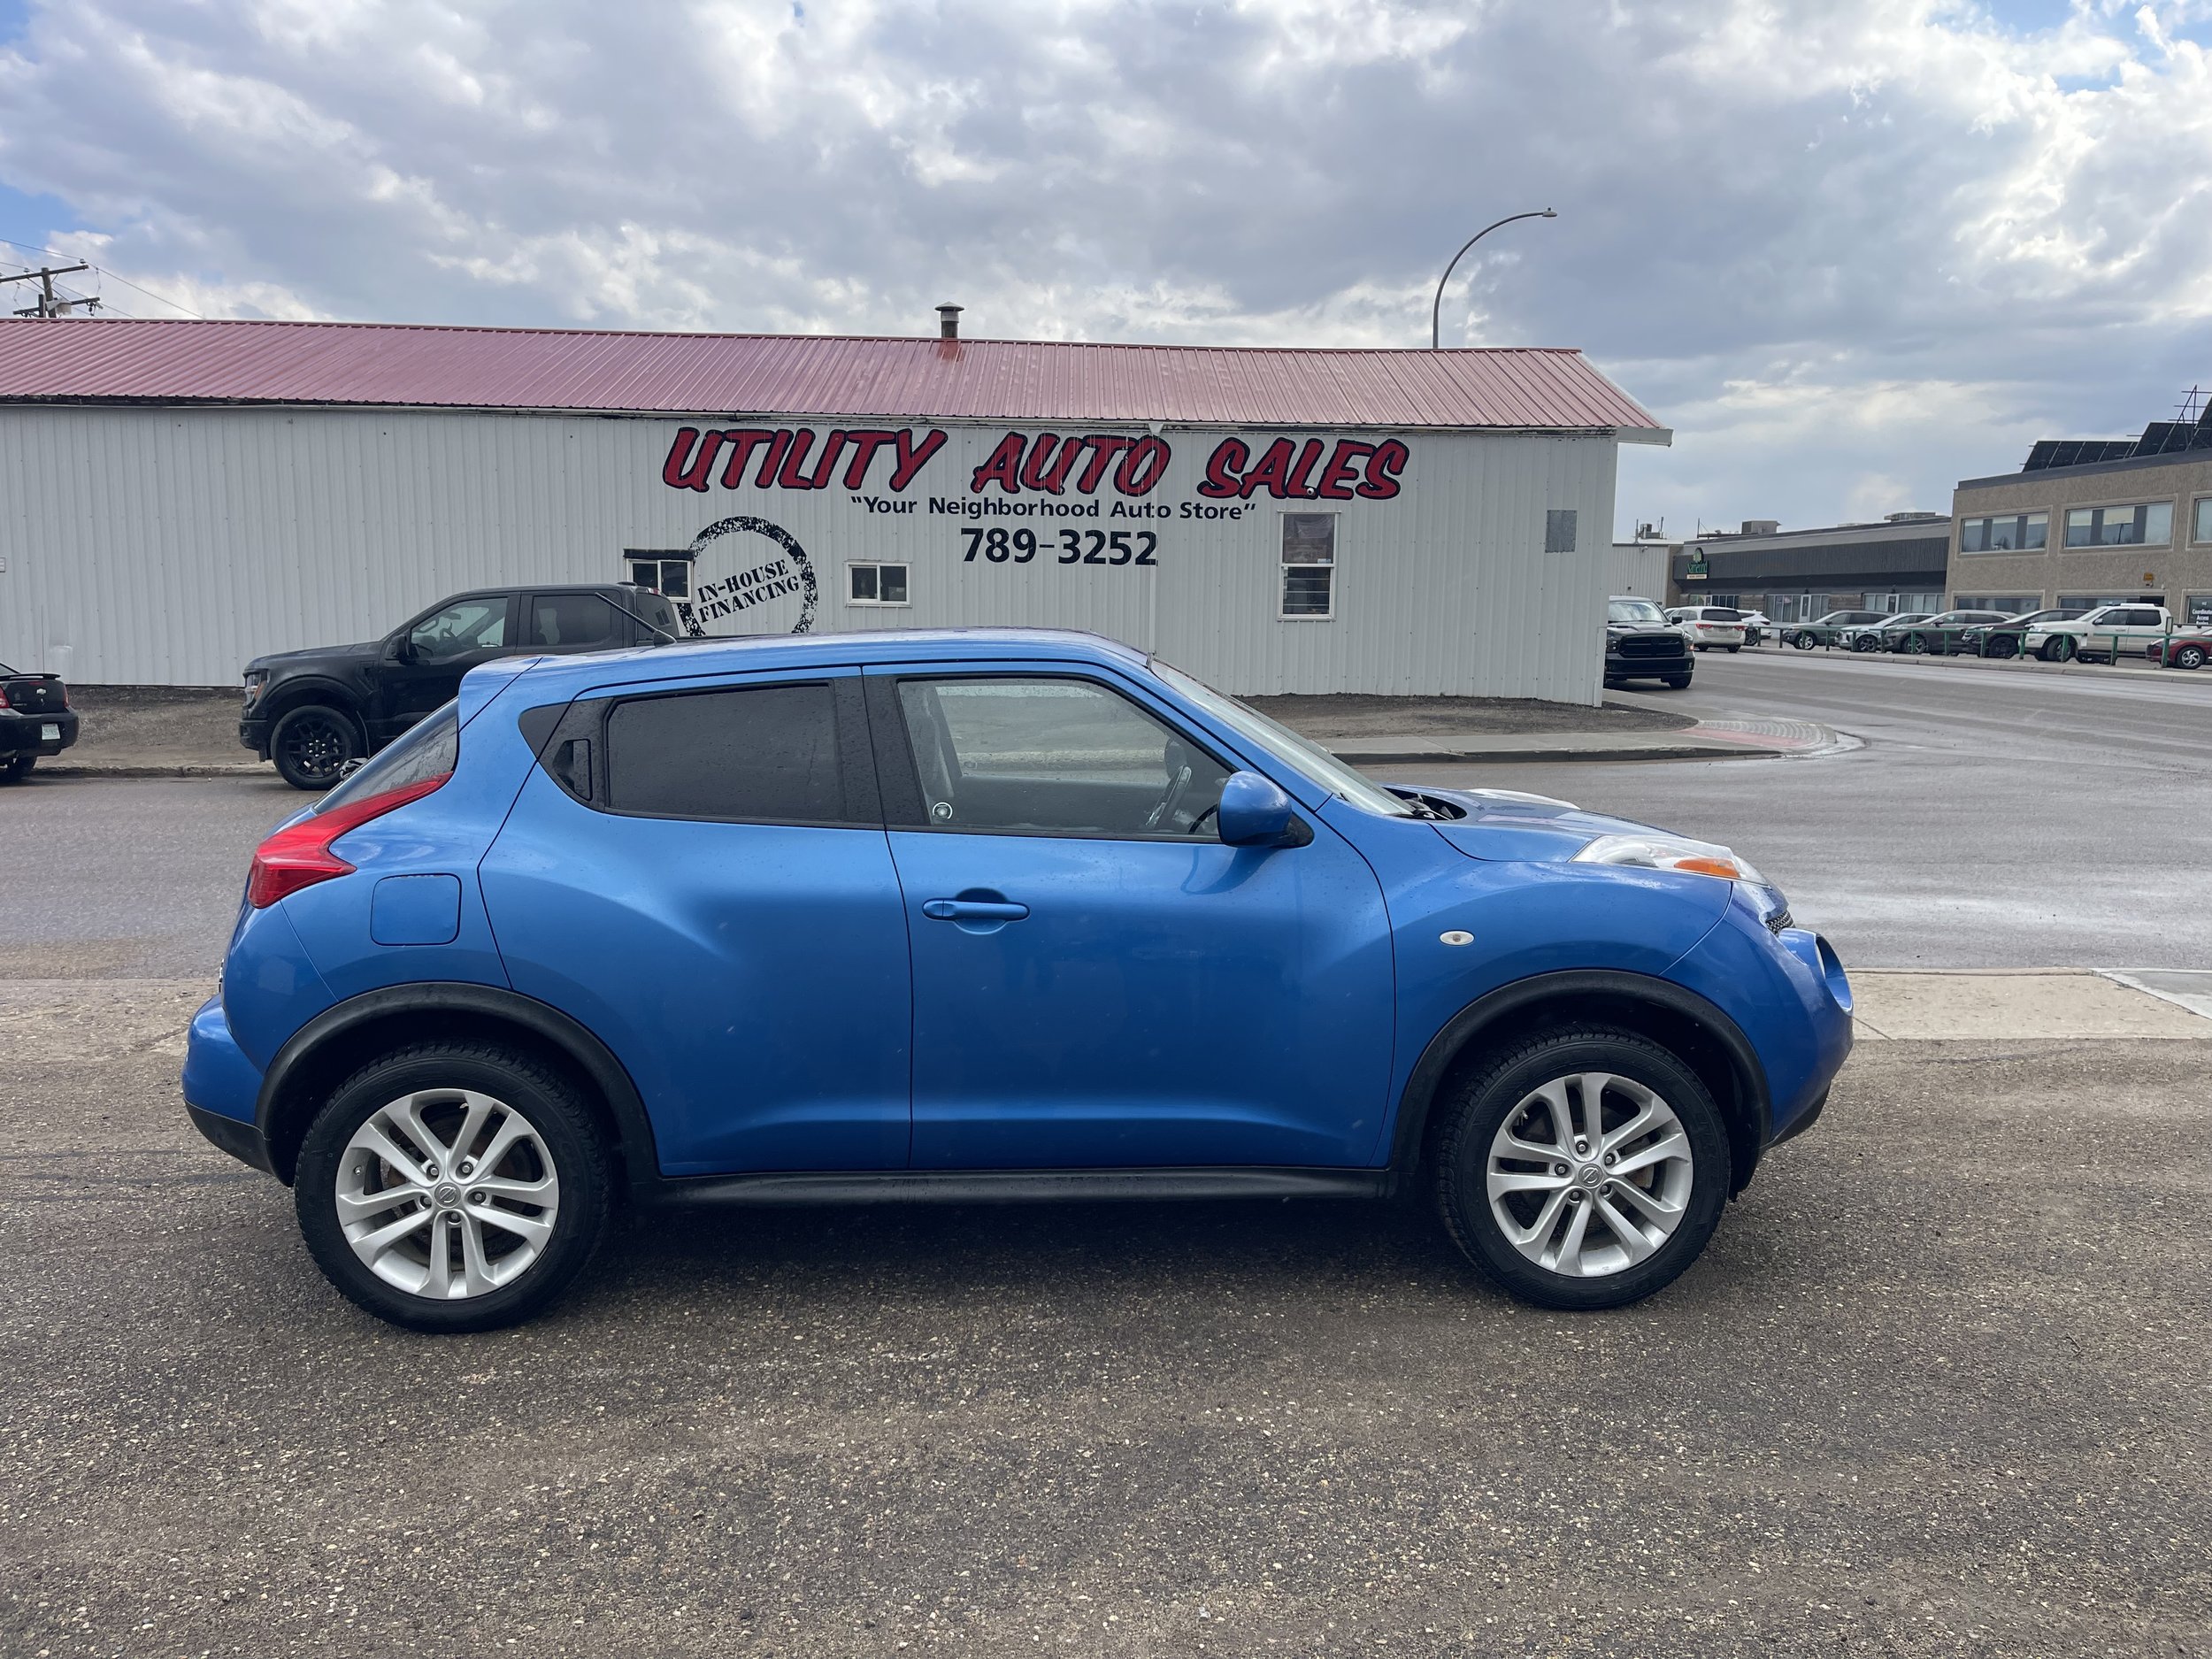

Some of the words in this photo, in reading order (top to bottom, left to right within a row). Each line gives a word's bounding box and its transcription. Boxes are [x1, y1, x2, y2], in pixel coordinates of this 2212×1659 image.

[663, 427, 949, 493] UTILITY
[971, 431, 1171, 495] AUTO
[1197, 437, 1410, 499] SALES
[928, 496, 1100, 520] Neighborhood
[1110, 501, 1172, 519] Auto
[960, 527, 1159, 567] 789-3252
[697, 559, 789, 603] IN-HOUSE
[698, 575, 800, 624] FINANCING
